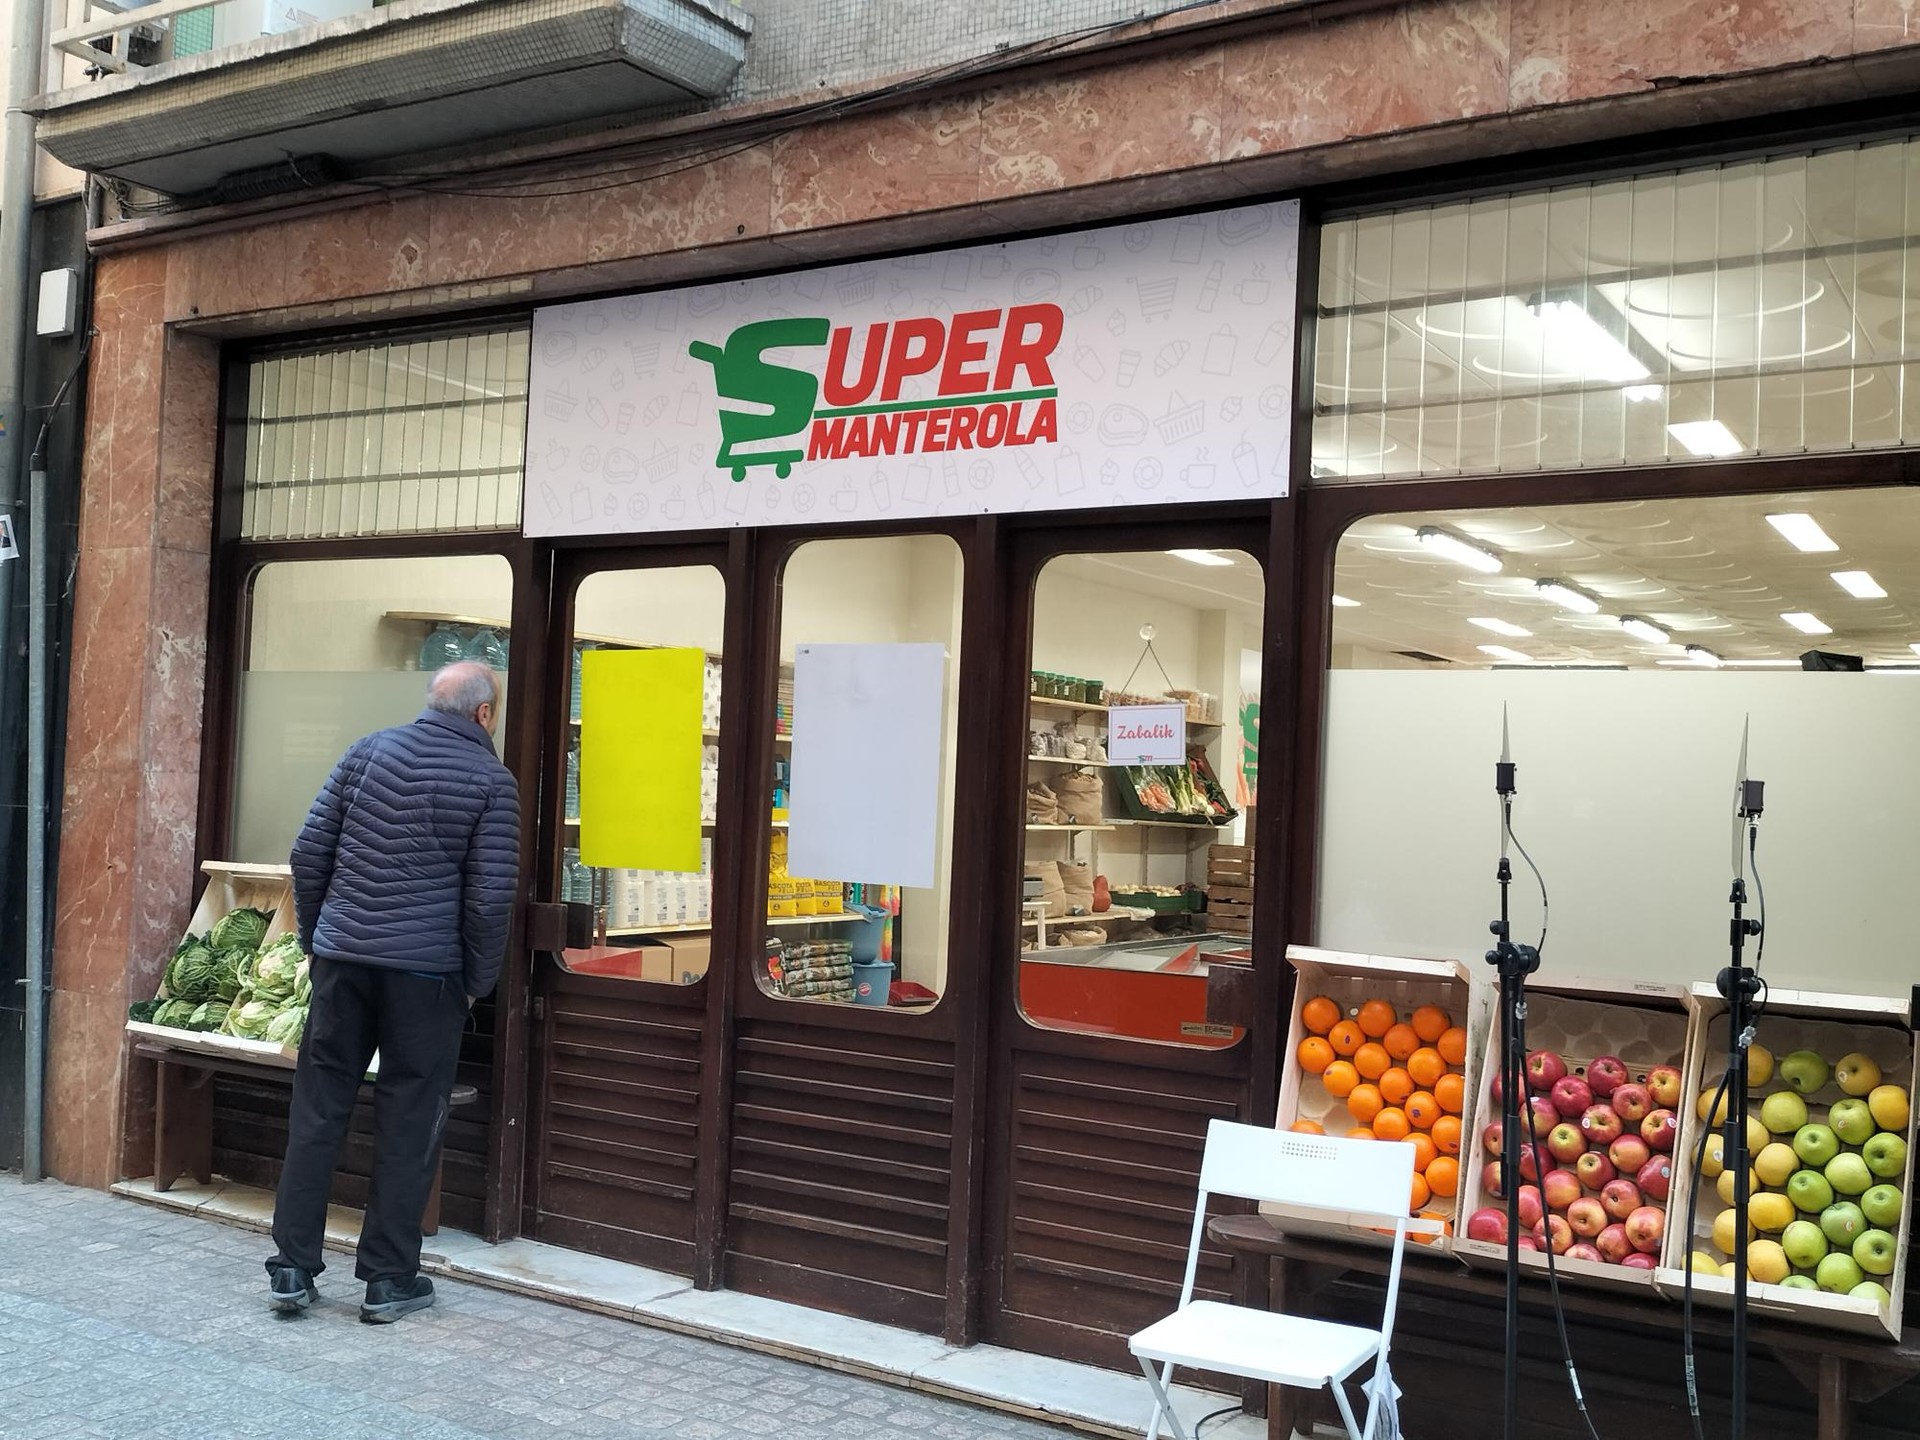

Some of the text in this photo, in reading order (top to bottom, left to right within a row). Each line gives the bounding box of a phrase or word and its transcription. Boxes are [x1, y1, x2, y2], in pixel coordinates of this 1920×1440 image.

[689, 303, 1064, 481] SUPER
[806, 399, 1058, 462] MANTEROLA
[1117, 724, 1175, 740] Zabalik
